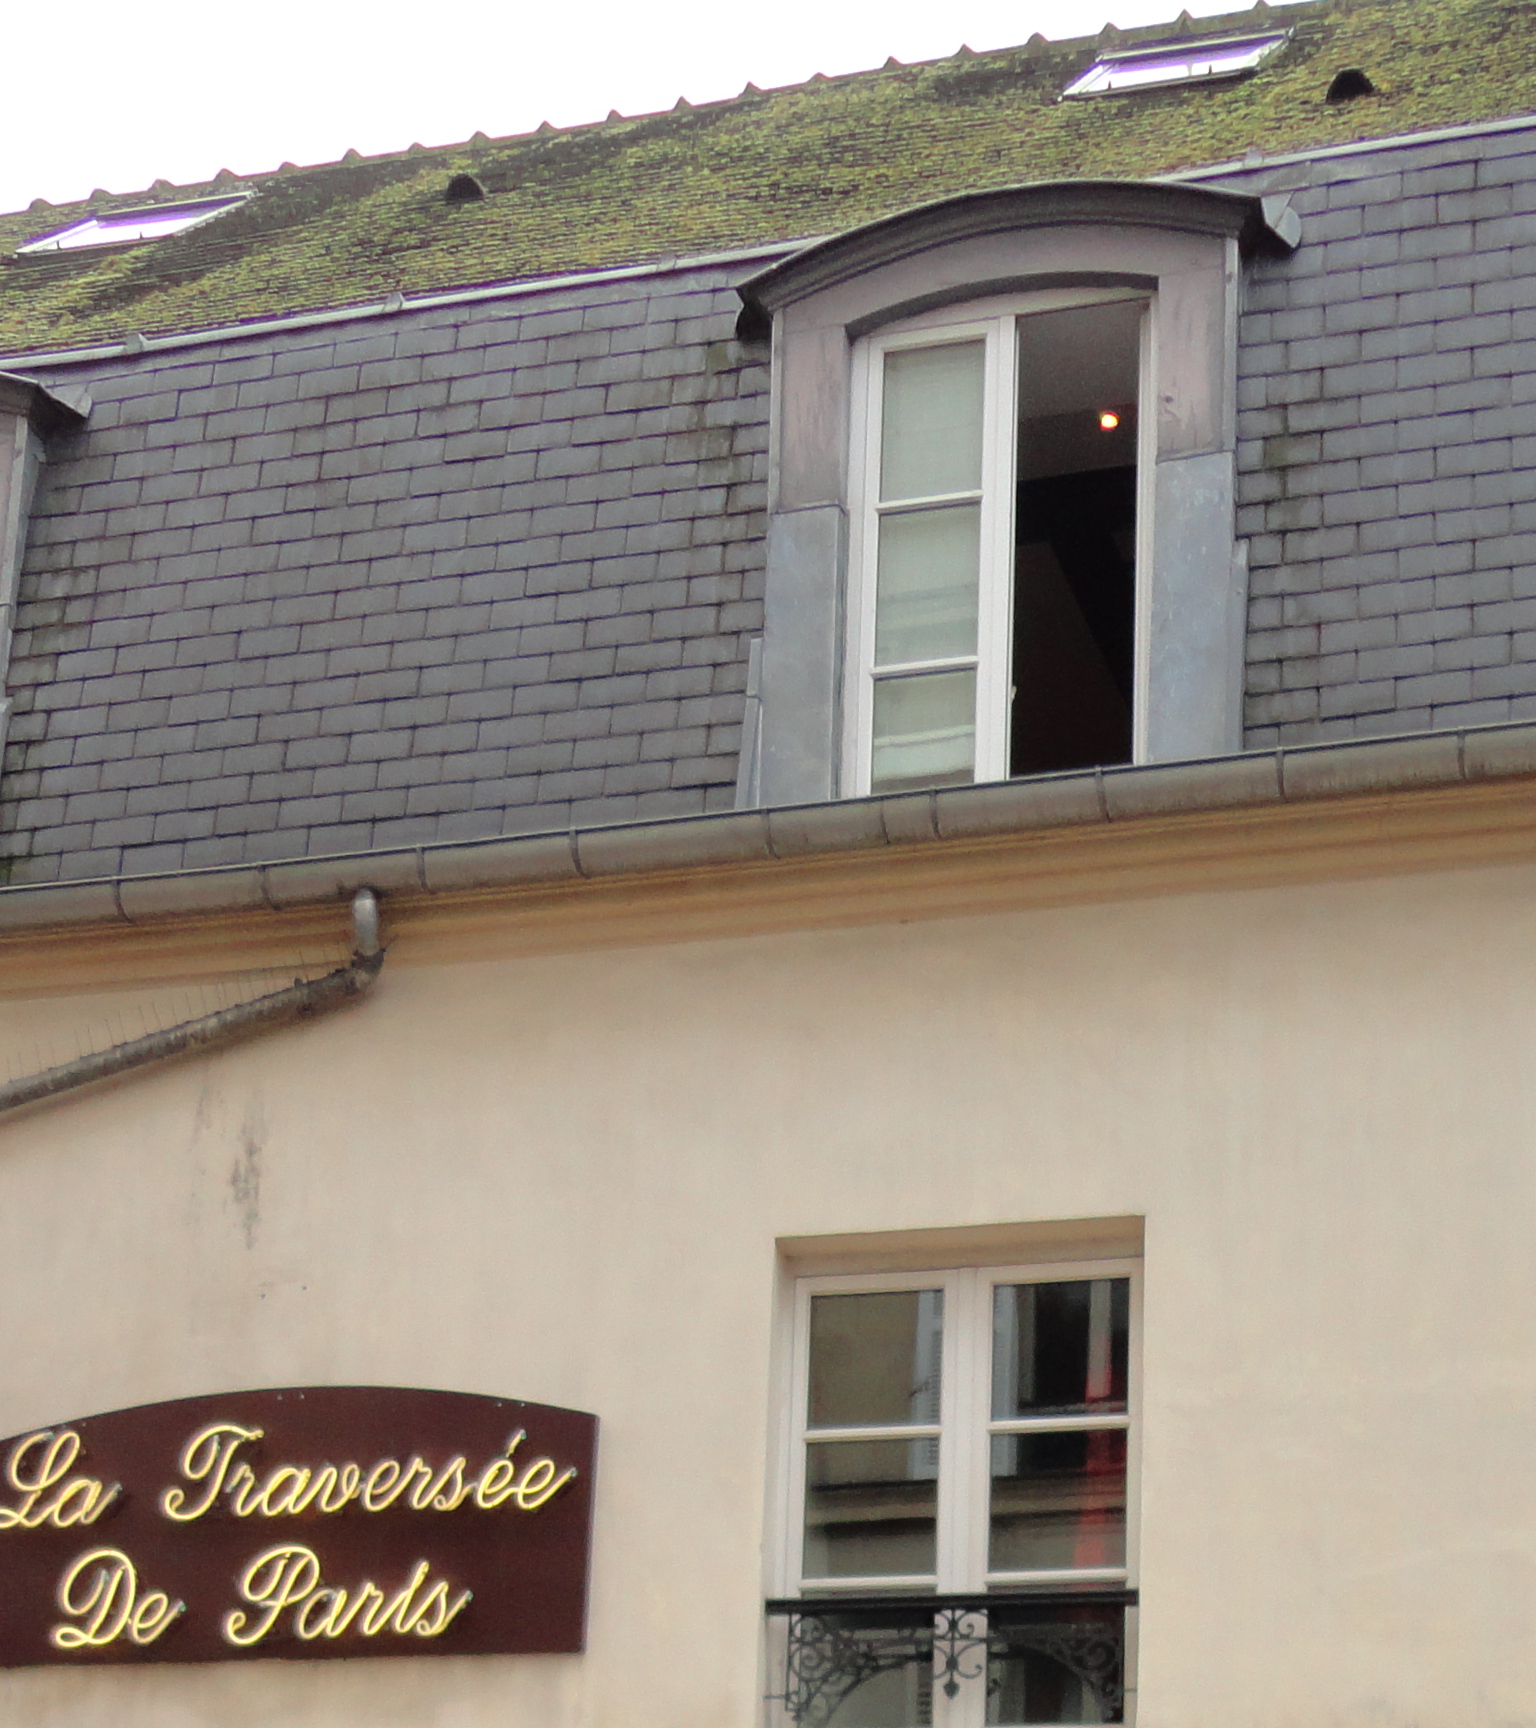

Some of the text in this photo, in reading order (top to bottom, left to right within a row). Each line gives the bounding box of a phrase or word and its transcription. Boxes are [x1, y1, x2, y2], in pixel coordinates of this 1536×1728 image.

[164, 1423, 577, 1522] Traversée
[50, 1544, 474, 1648] De Paris
